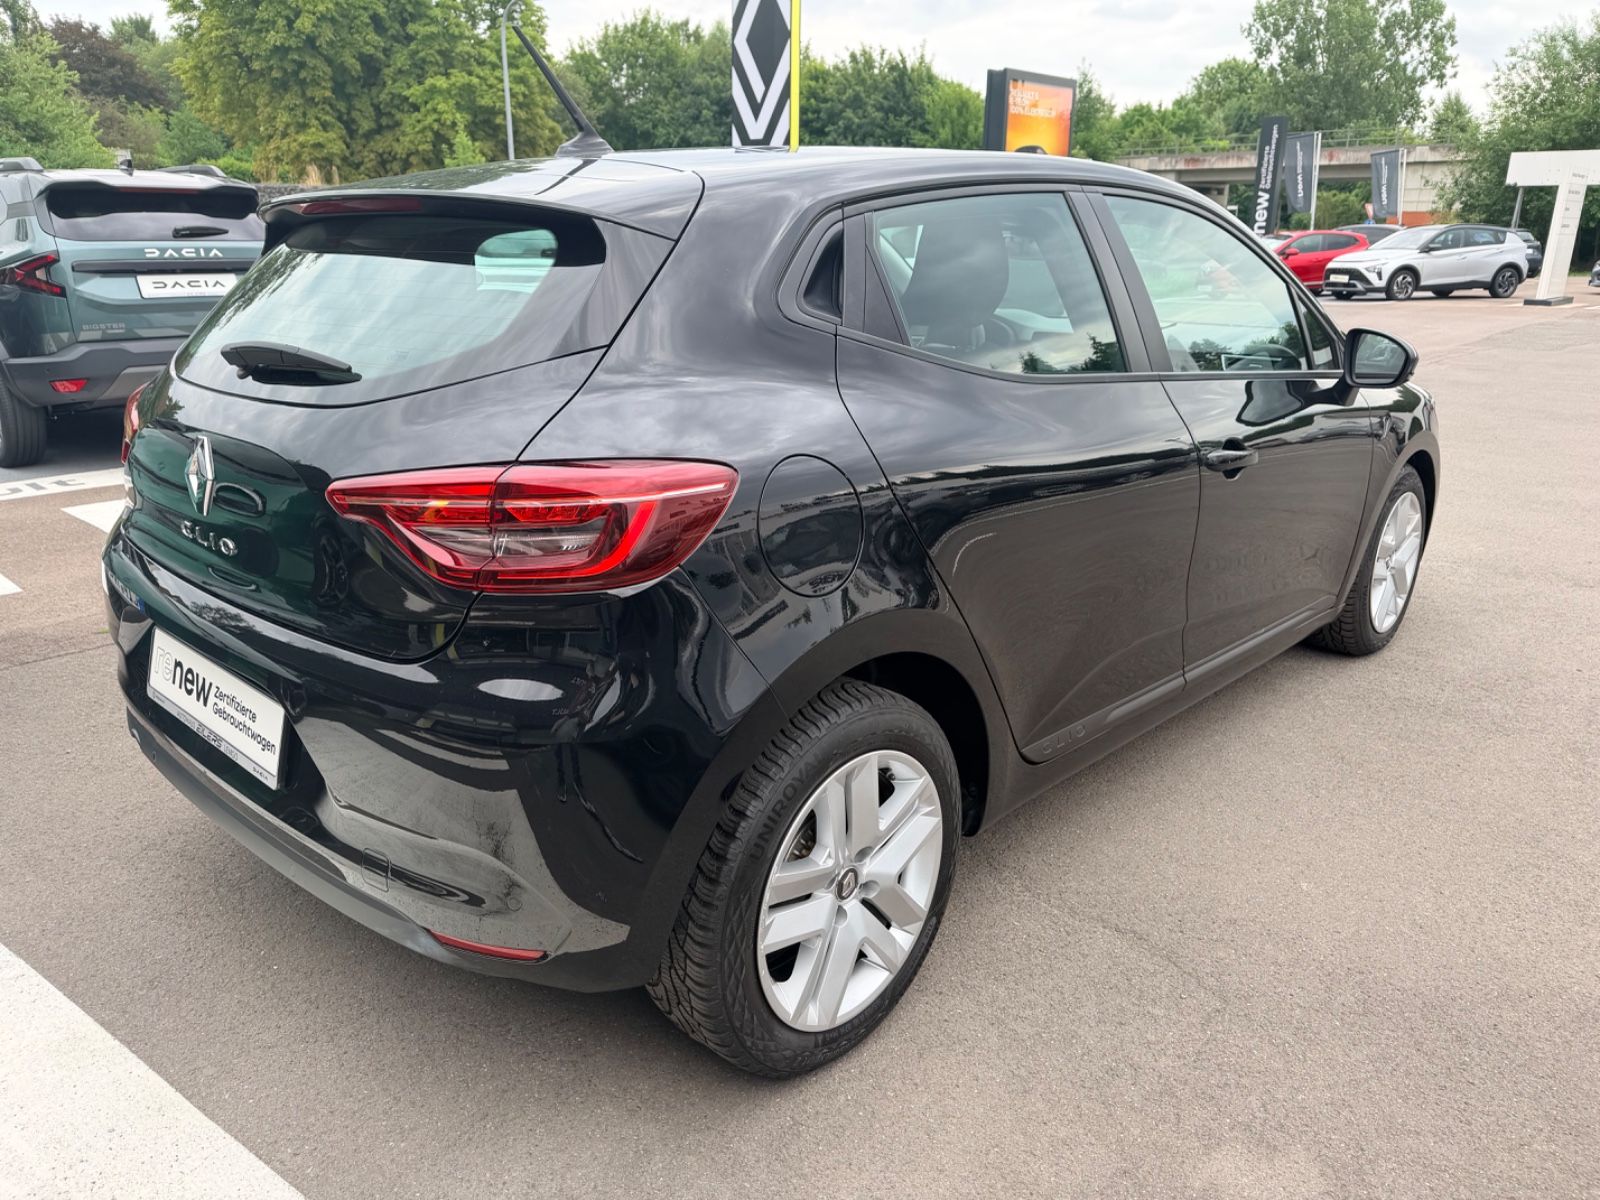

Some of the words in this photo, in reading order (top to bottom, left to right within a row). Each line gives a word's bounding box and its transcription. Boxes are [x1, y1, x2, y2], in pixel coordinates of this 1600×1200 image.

[1253, 191, 1270, 236] new
[144, 248, 223, 257] DACIA
[152, 280, 226, 289] DACIA
[82, 322, 125, 330] BIGSTER
[181, 520, 238, 556] CLIO
[214, 685, 257, 723] Zertifizierte
[212, 702, 276, 755] Gebrauchtwagen
[1041, 725, 1086, 754] CLIO
